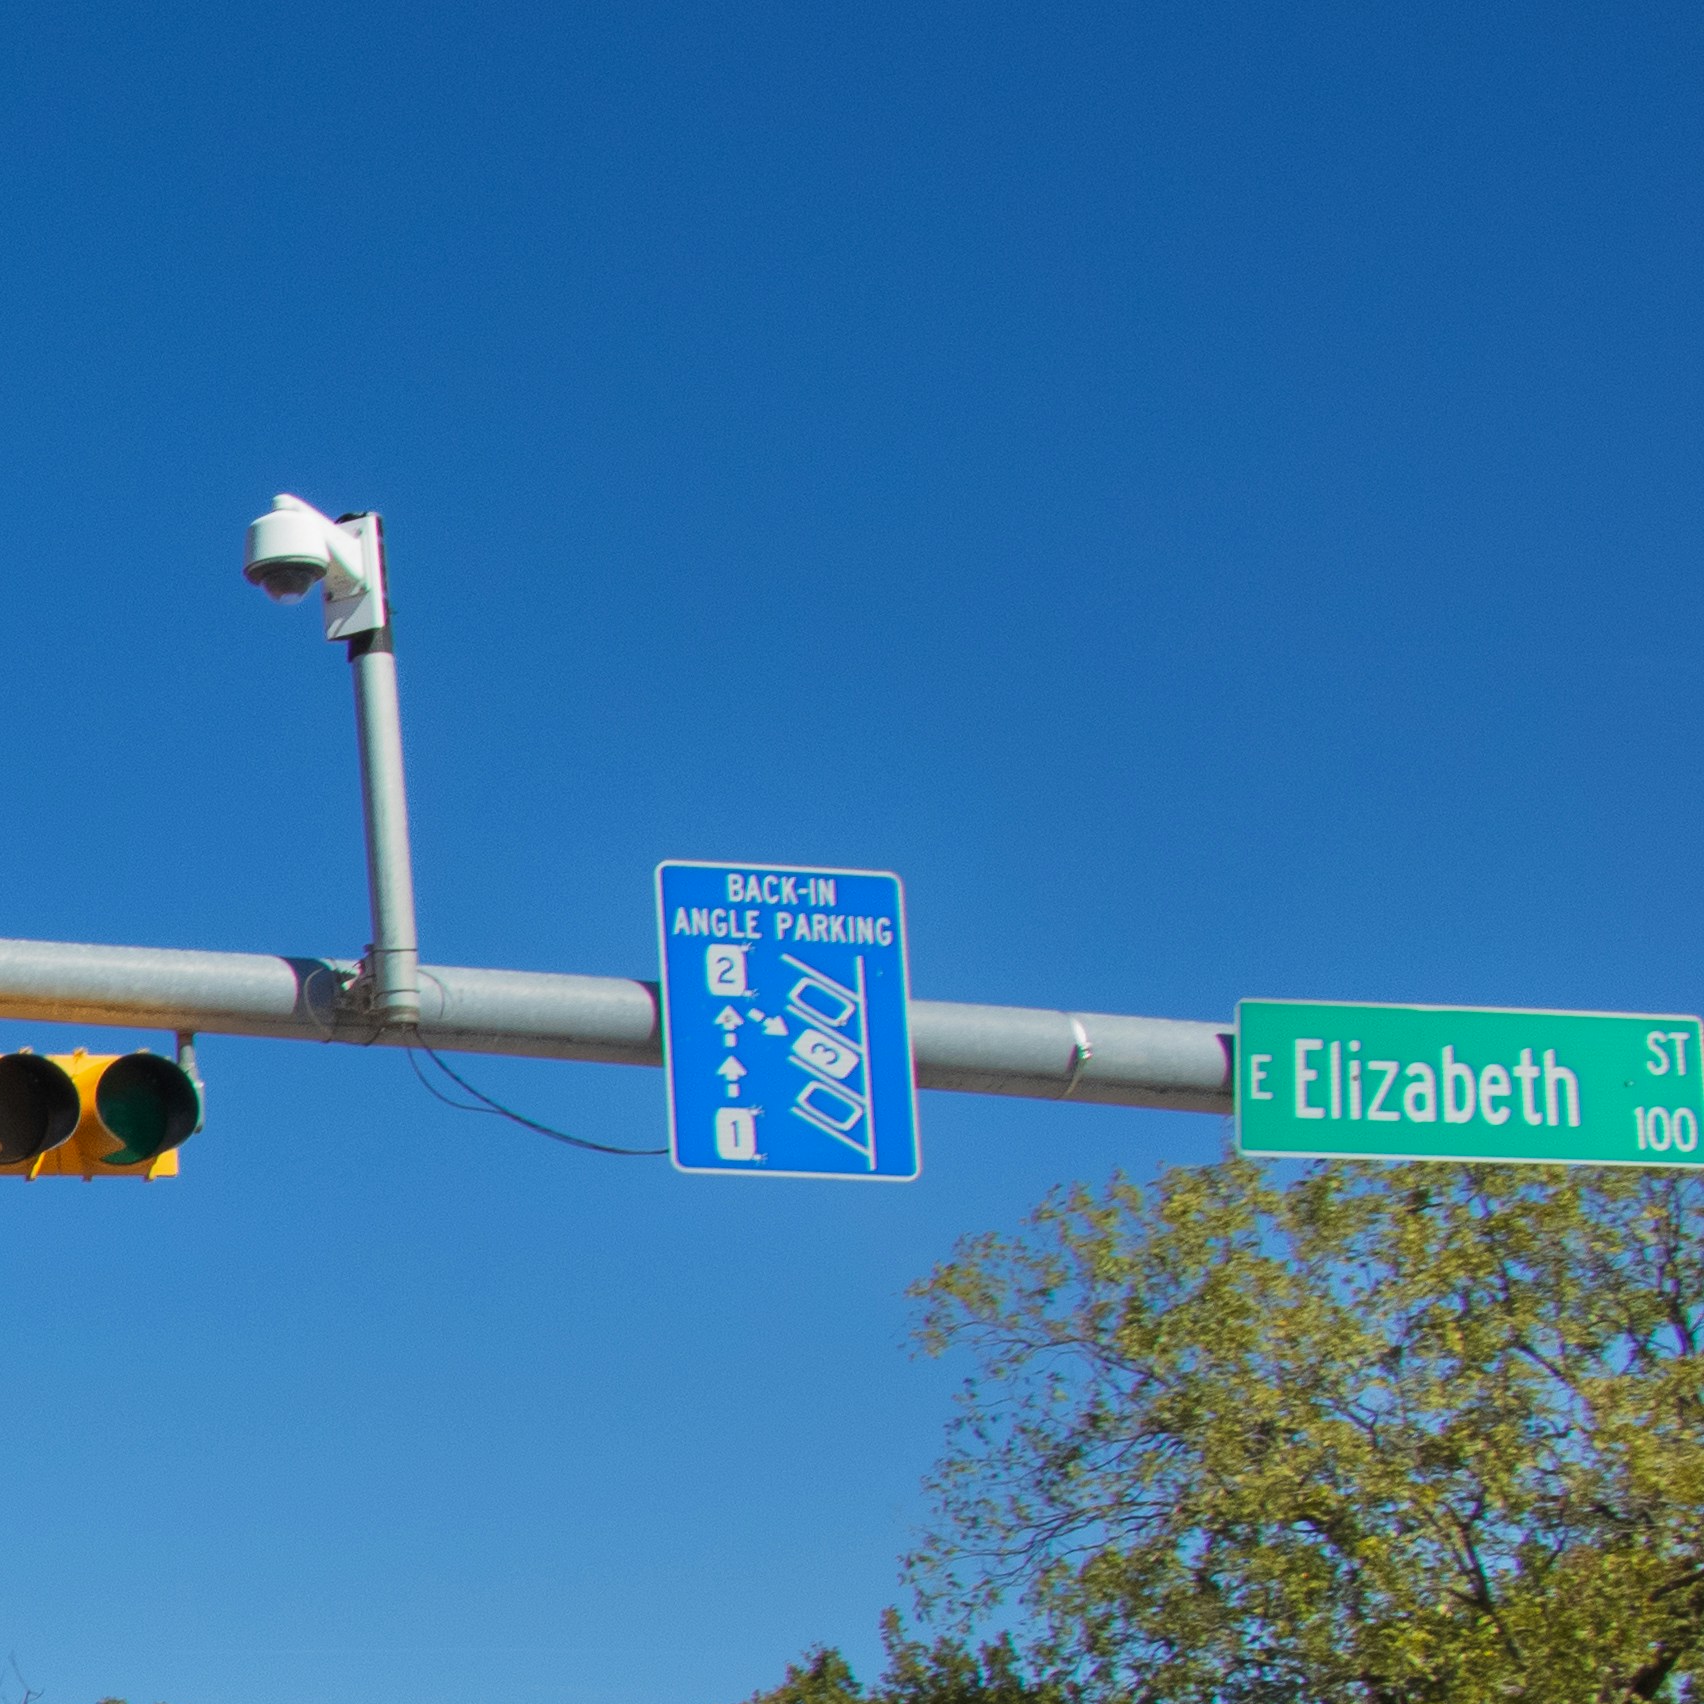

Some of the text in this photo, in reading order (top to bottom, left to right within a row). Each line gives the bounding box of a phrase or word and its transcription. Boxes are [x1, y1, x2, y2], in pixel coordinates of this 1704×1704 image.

[725, 873, 837, 907] BACK-IN
[673, 906, 893, 947] ANGLE PARKING
[715, 956, 735, 984] 2
[809, 1041, 841, 1066] 3
[1645, 1030, 1690, 1077] ST
[1250, 1038, 1582, 1128] E Elizabeth
[729, 1120, 740, 1149] 1
[1634, 1105, 1698, 1153] 100
